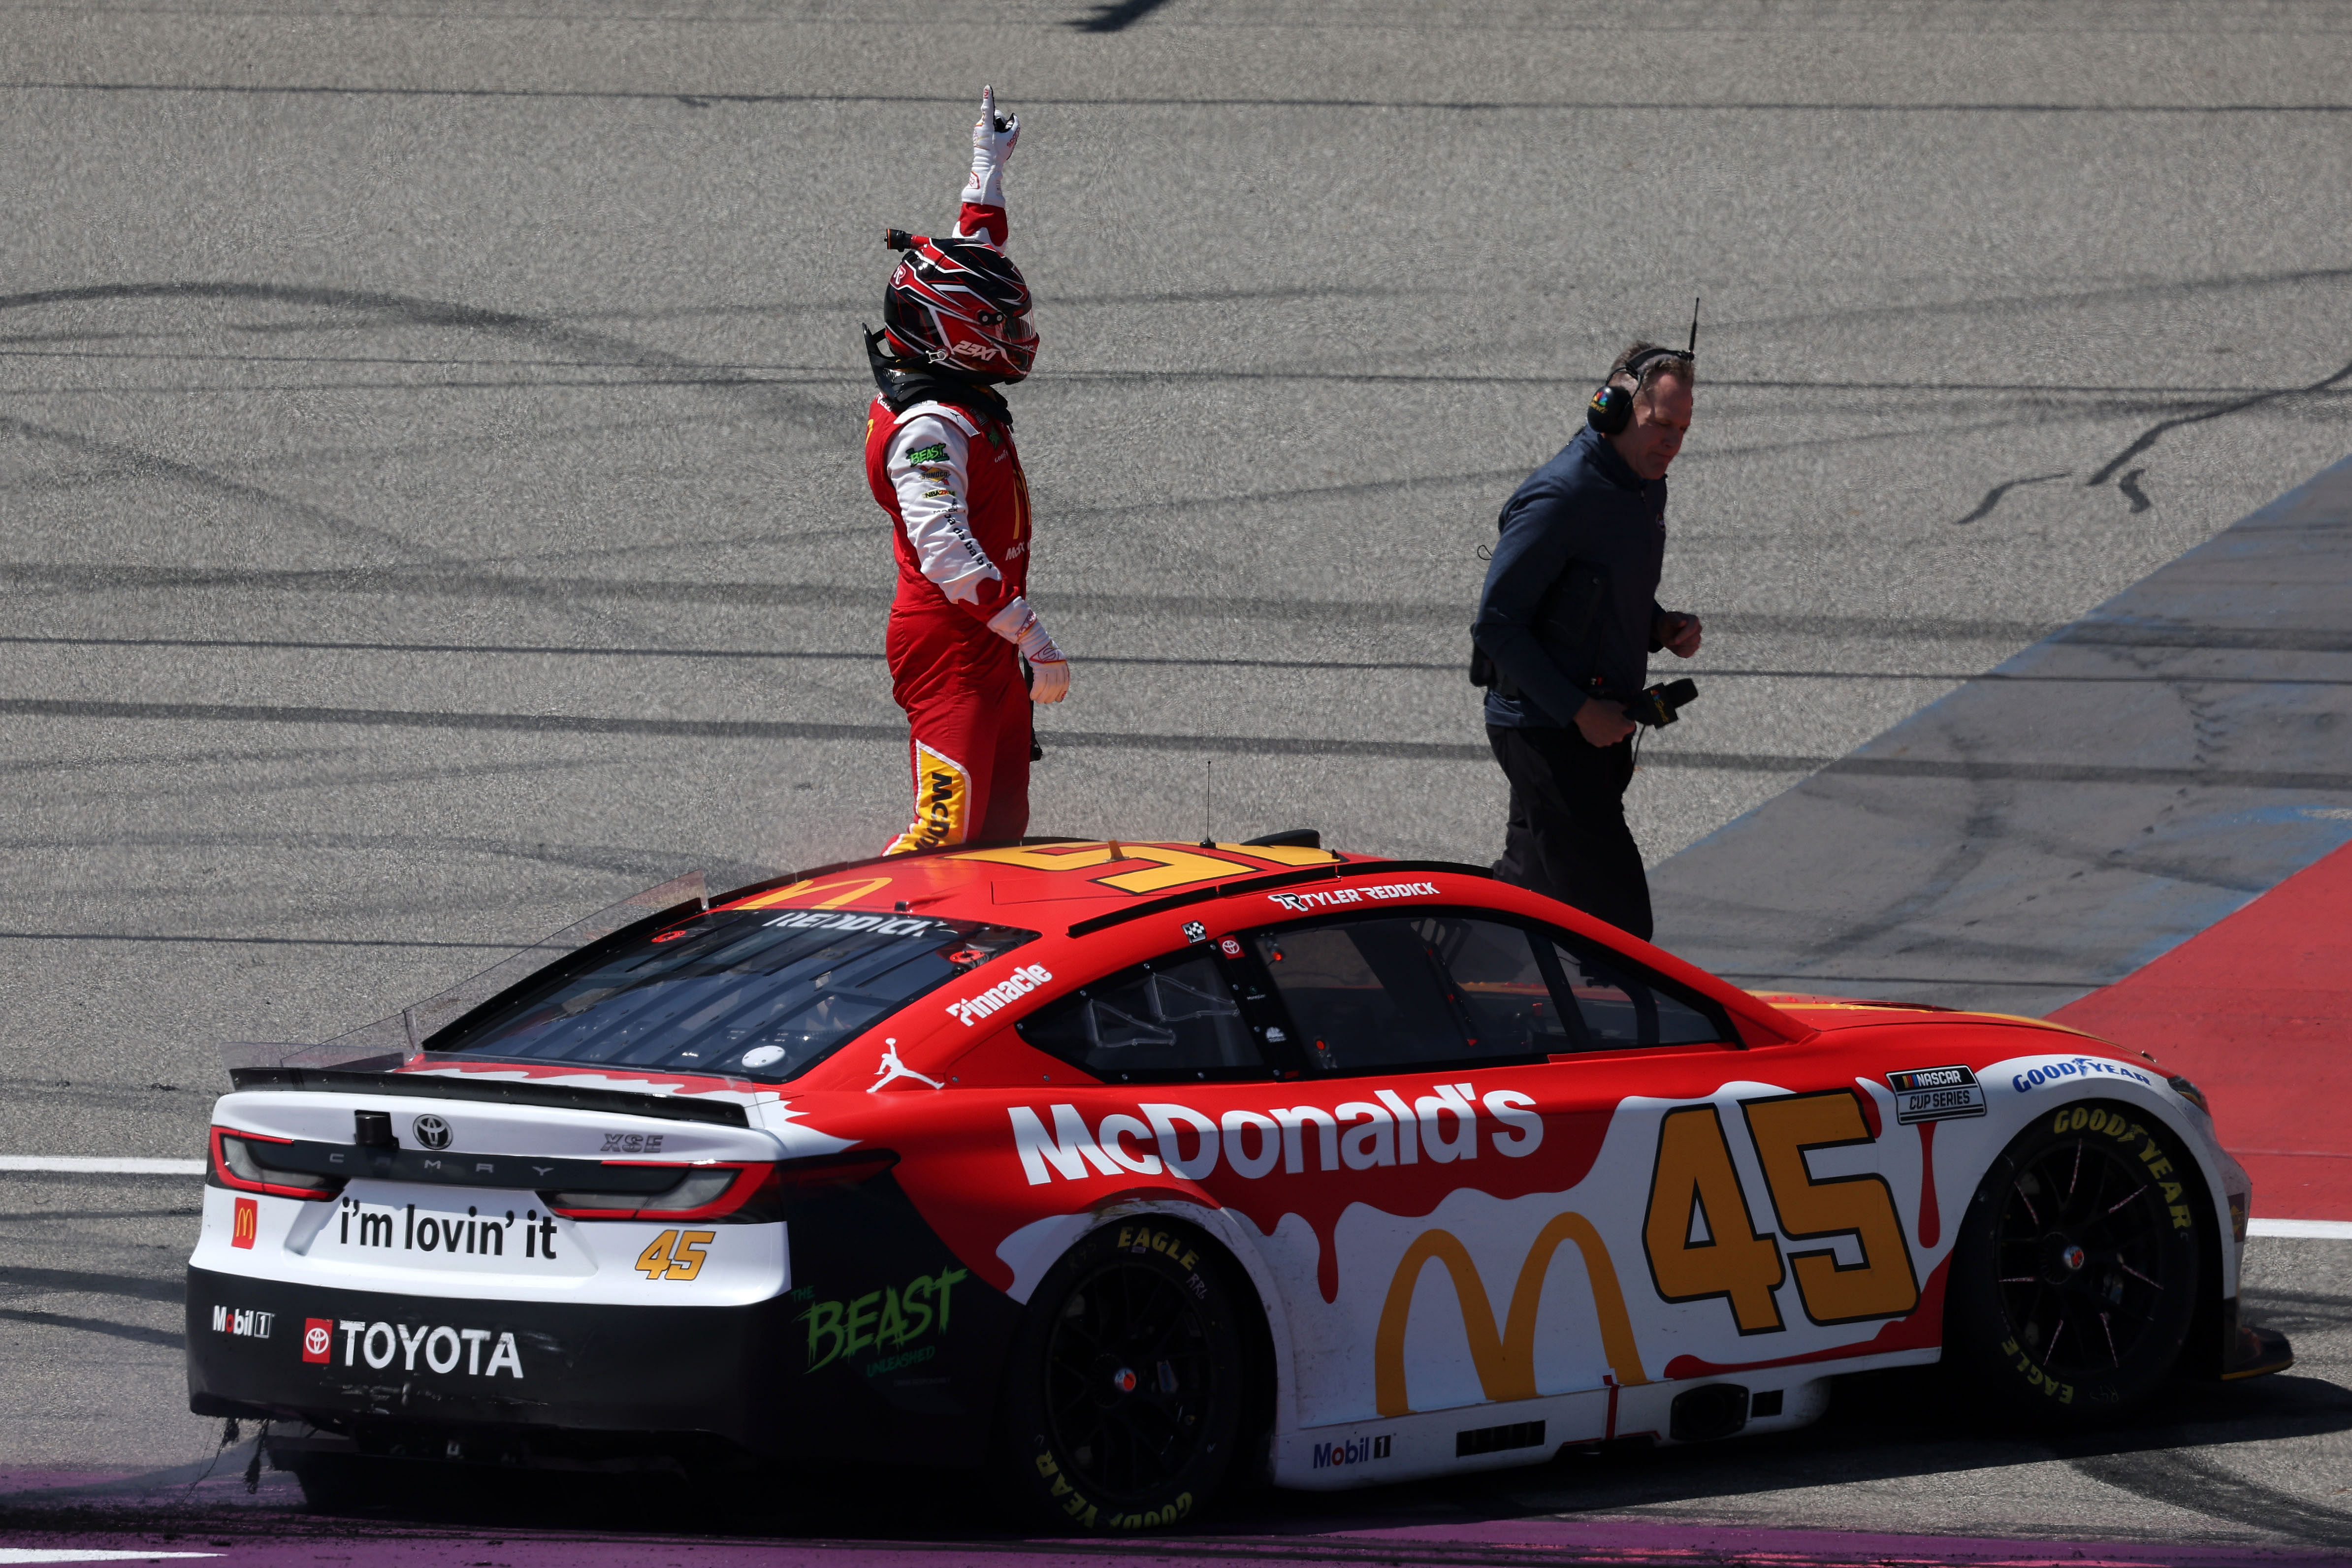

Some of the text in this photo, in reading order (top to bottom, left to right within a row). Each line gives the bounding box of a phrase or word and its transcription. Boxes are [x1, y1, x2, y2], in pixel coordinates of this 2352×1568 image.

[910, 444, 946, 465] BEAST
[921, 471, 950, 480] SUNOCO
[964, 541, 977, 556] ba
[1300, 889, 1363, 907] TYLER
[1357, 882, 1440, 899] REDDICK
[946, 963, 1053, 1026] Pinnacle
[1916, 1070, 1962, 1087] NASCAR
[2012, 1058, 2152, 1092] GOODYEAR
[1909, 1090, 1970, 1110] CUP SERIES
[601, 1133, 664, 1153] XSE
[1007, 1083, 1545, 1185] McDonald's
[329, 1153, 554, 1177] CAMRY
[2054, 1107, 2192, 1230] GOODYEAR
[340, 1197, 557, 1259] i'm lovin' it
[1642, 1087, 1921, 1336] 45
[635, 1229, 716, 1281] 45
[1117, 1226, 1200, 1271] EAGLE
[791, 1285, 815, 1303] THE
[212, 1305, 253, 1336] Mobil
[792, 1265, 968, 1374] BEAST
[339, 1319, 524, 1378] TOYOTA
[867, 1345, 935, 1378] UNLEASHED
[2000, 1335, 2074, 1405] EAGLE
[1313, 1437, 1370, 1469] Mobil
